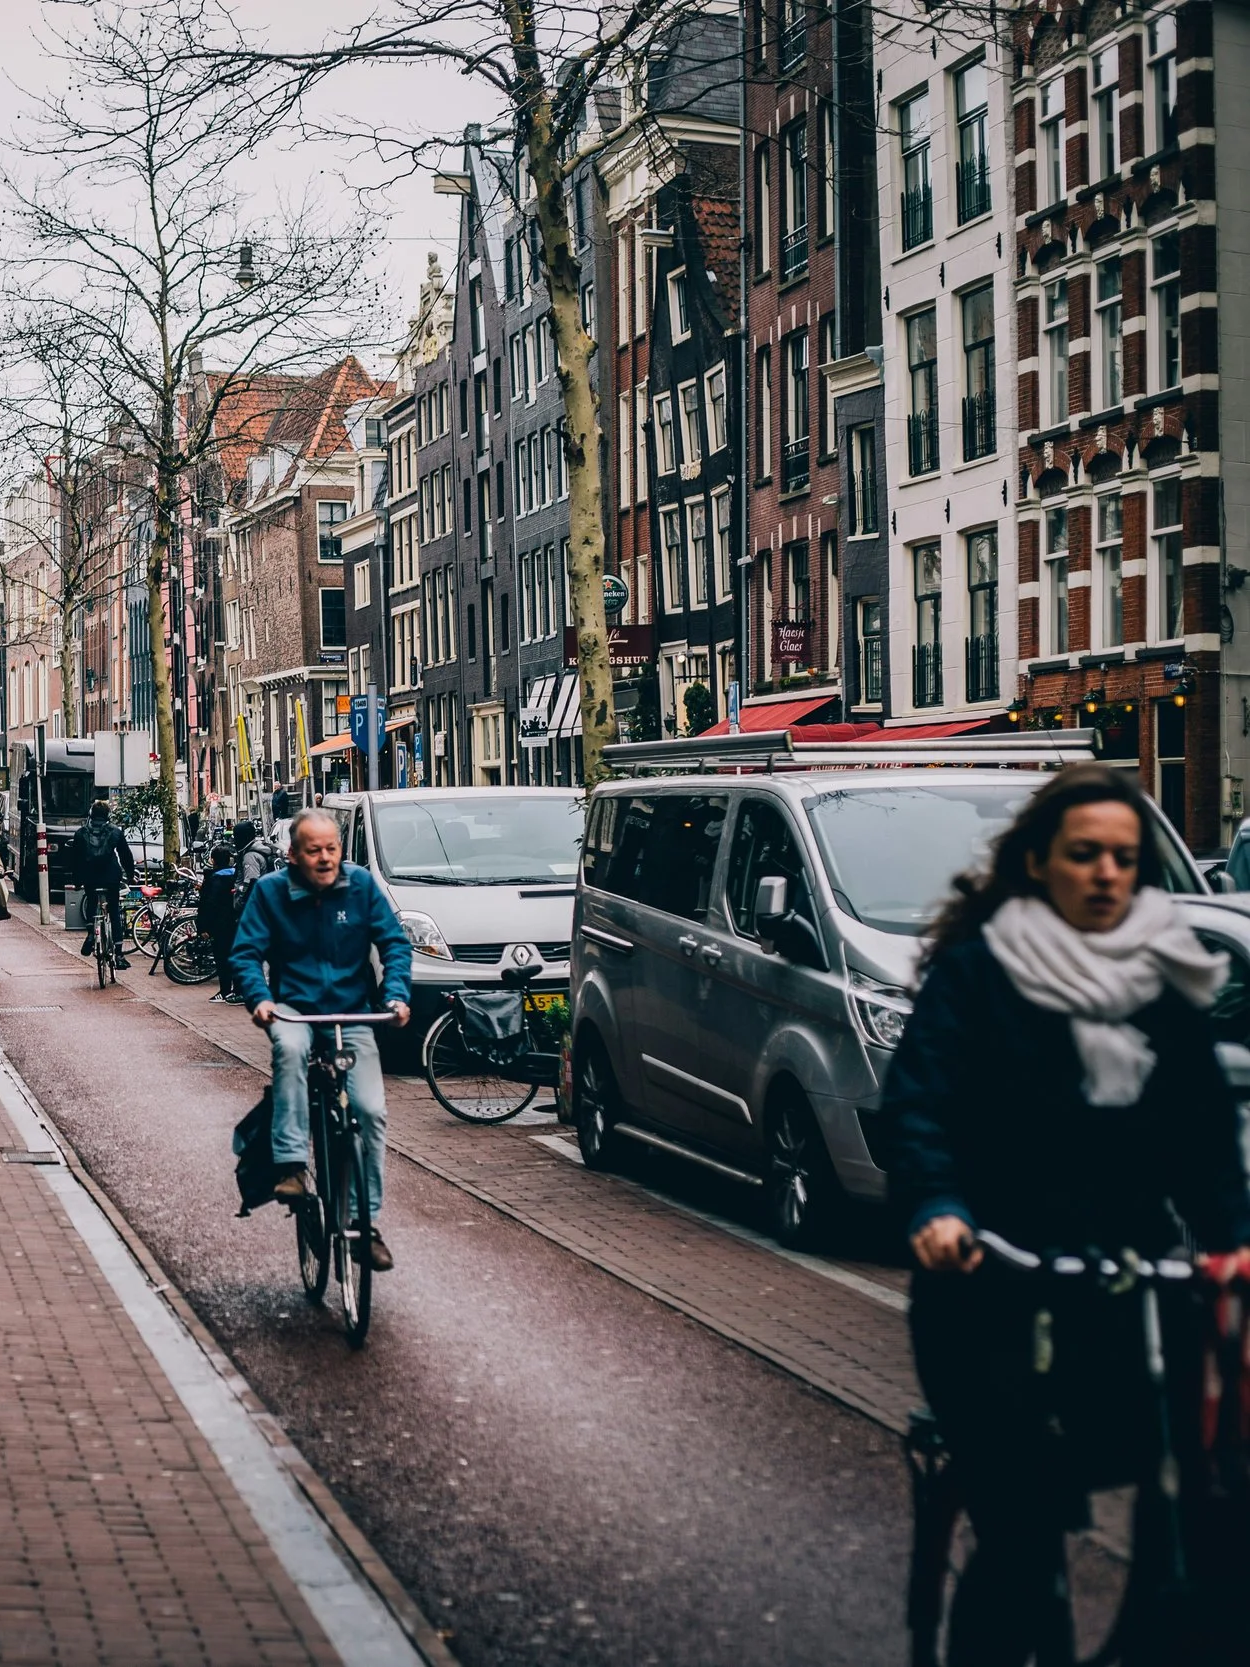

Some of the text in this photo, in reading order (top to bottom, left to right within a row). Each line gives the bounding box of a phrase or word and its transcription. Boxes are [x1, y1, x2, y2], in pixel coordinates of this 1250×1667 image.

[356, 713, 363, 735] P
[378, 713, 383, 735] P
[398, 749, 405, 783] P
